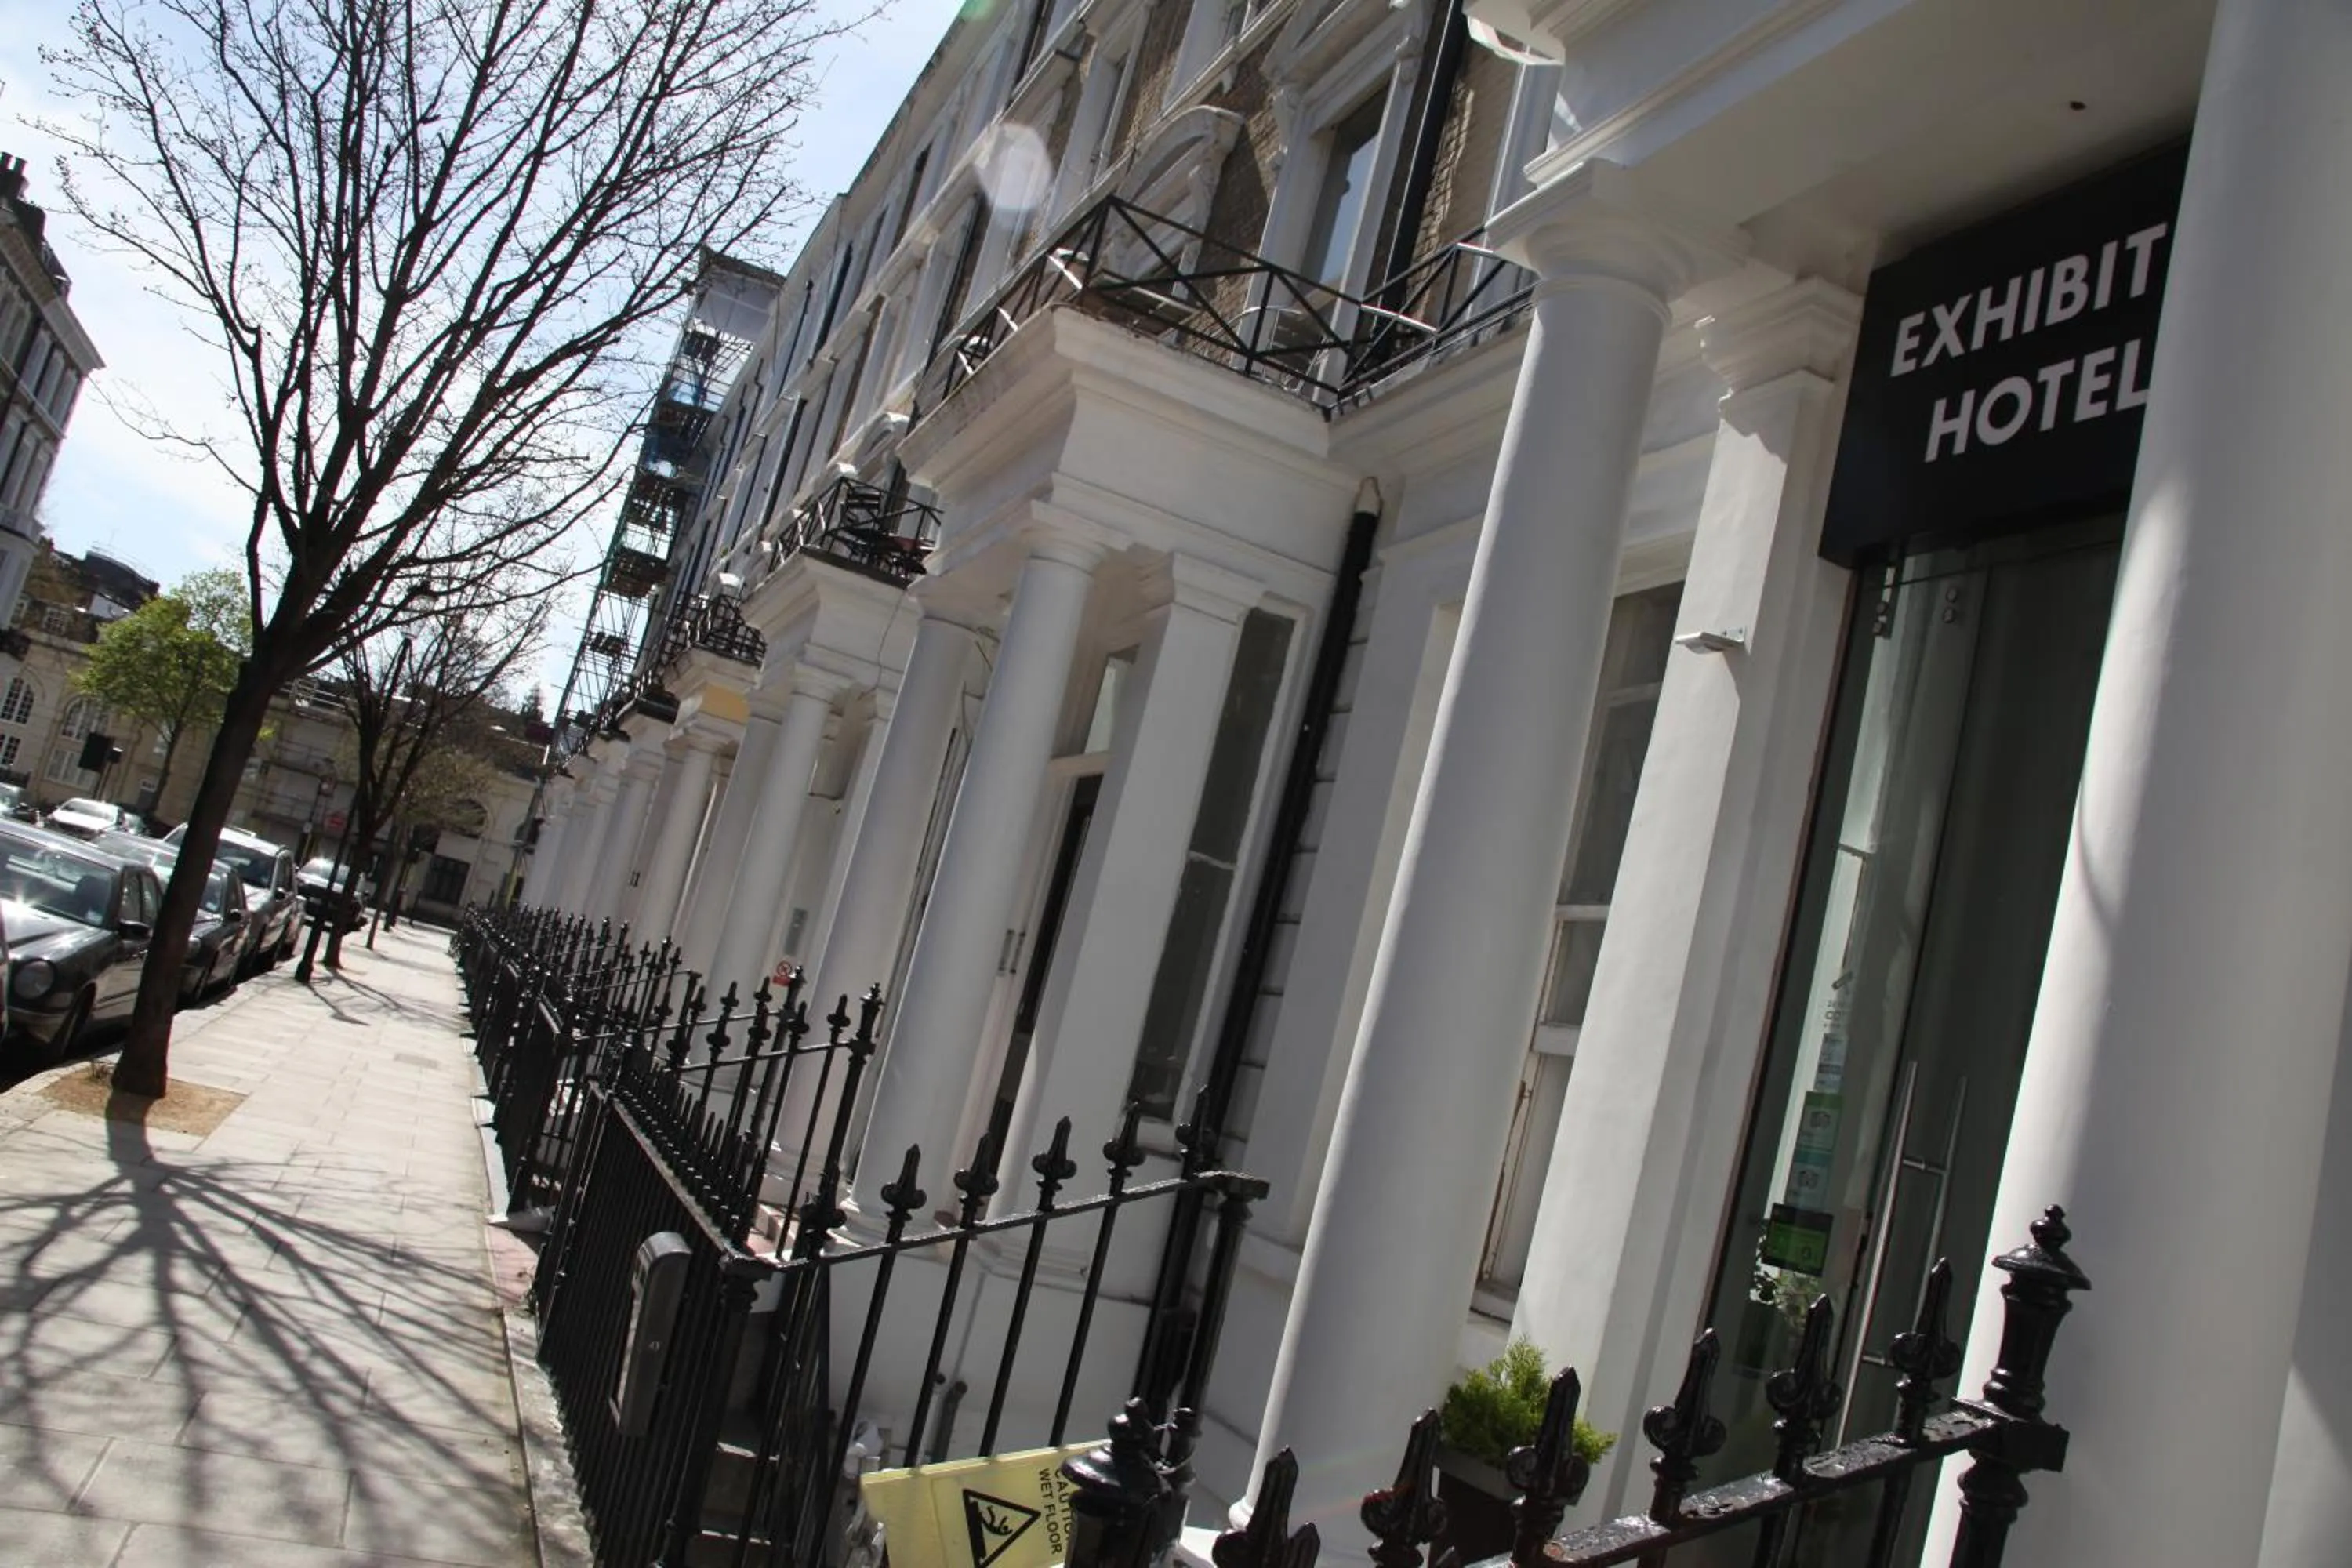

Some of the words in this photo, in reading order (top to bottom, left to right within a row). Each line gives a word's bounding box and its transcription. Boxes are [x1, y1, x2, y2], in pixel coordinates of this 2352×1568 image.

[1890, 222, 2168, 377] EXHIBIT
[1925, 339, 2150, 463] HOTEL
[1039, 1468, 1054, 1499] WET
[1054, 1468, 1073, 1541] CAUTIO
[1044, 1504, 1062, 1555] FLOOR
